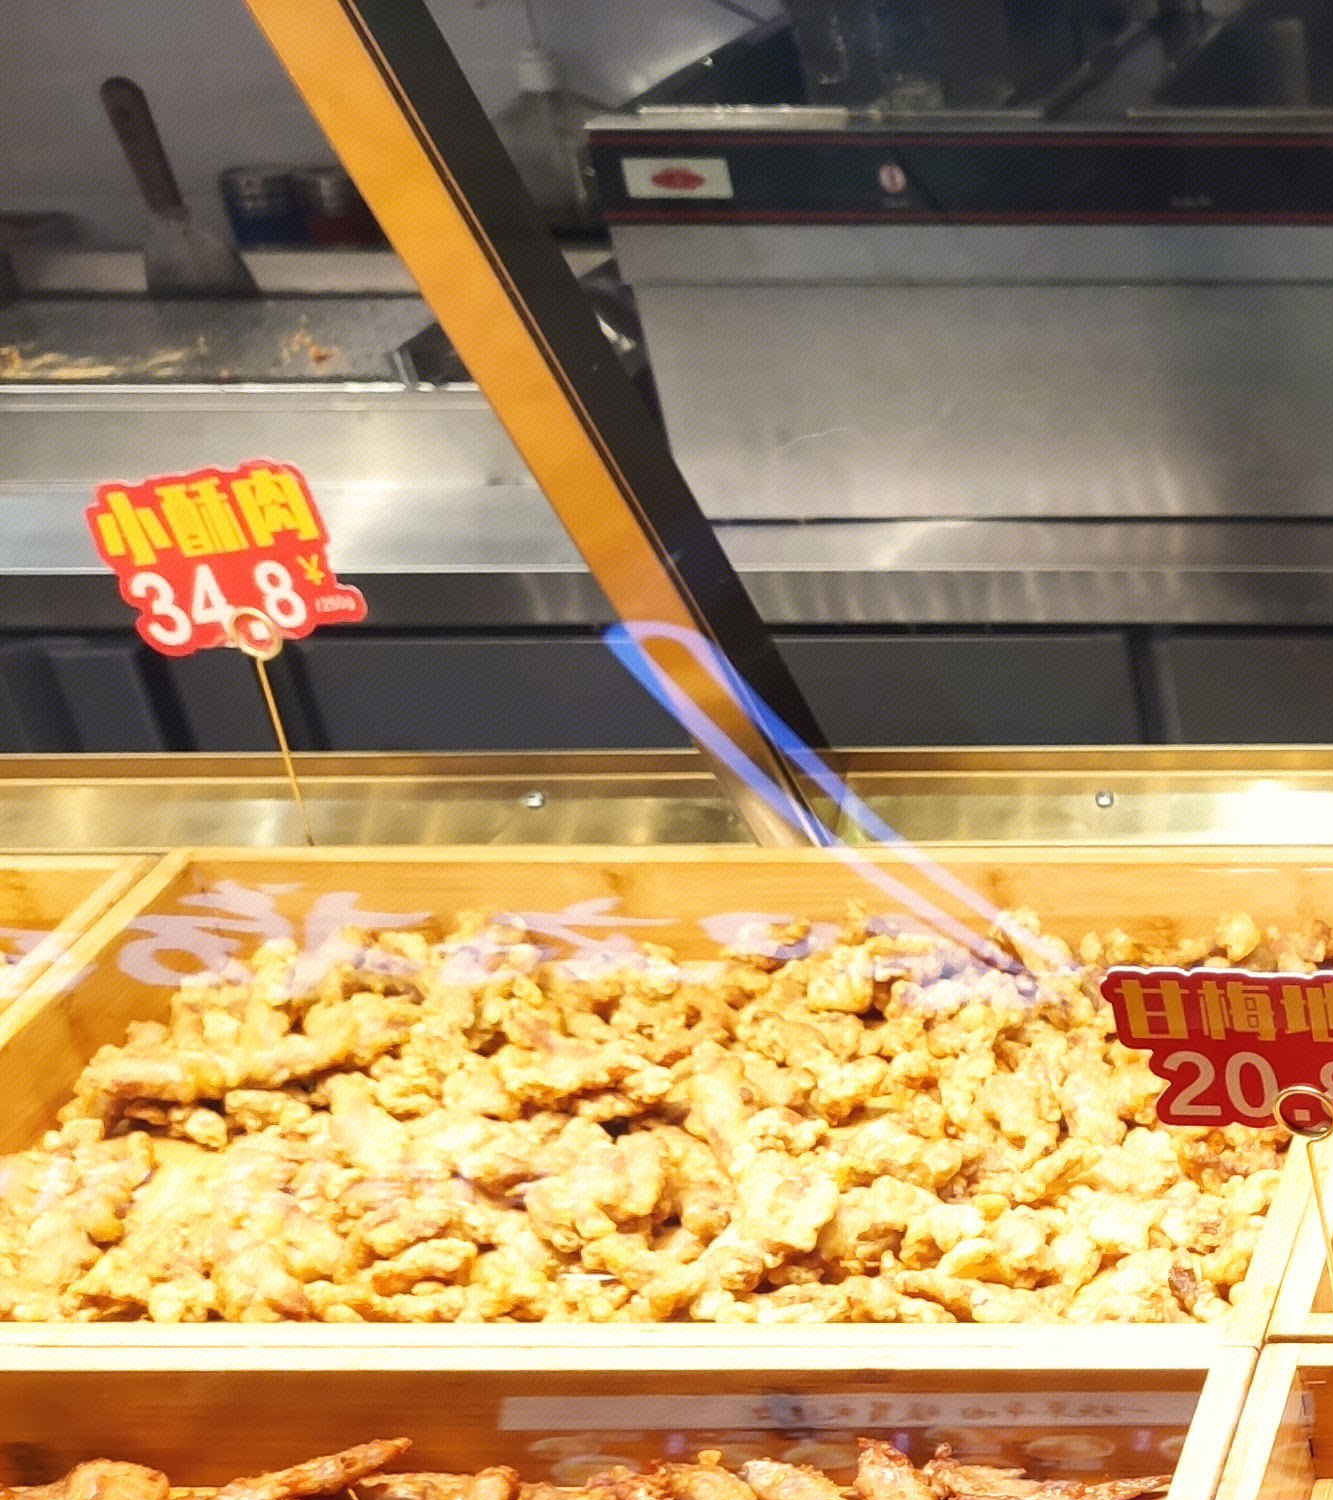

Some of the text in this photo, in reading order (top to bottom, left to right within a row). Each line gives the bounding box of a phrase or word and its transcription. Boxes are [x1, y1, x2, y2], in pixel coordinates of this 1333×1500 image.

[97, 467, 320, 566] 小酥肉
[131, 559, 308, 647] 34.8
